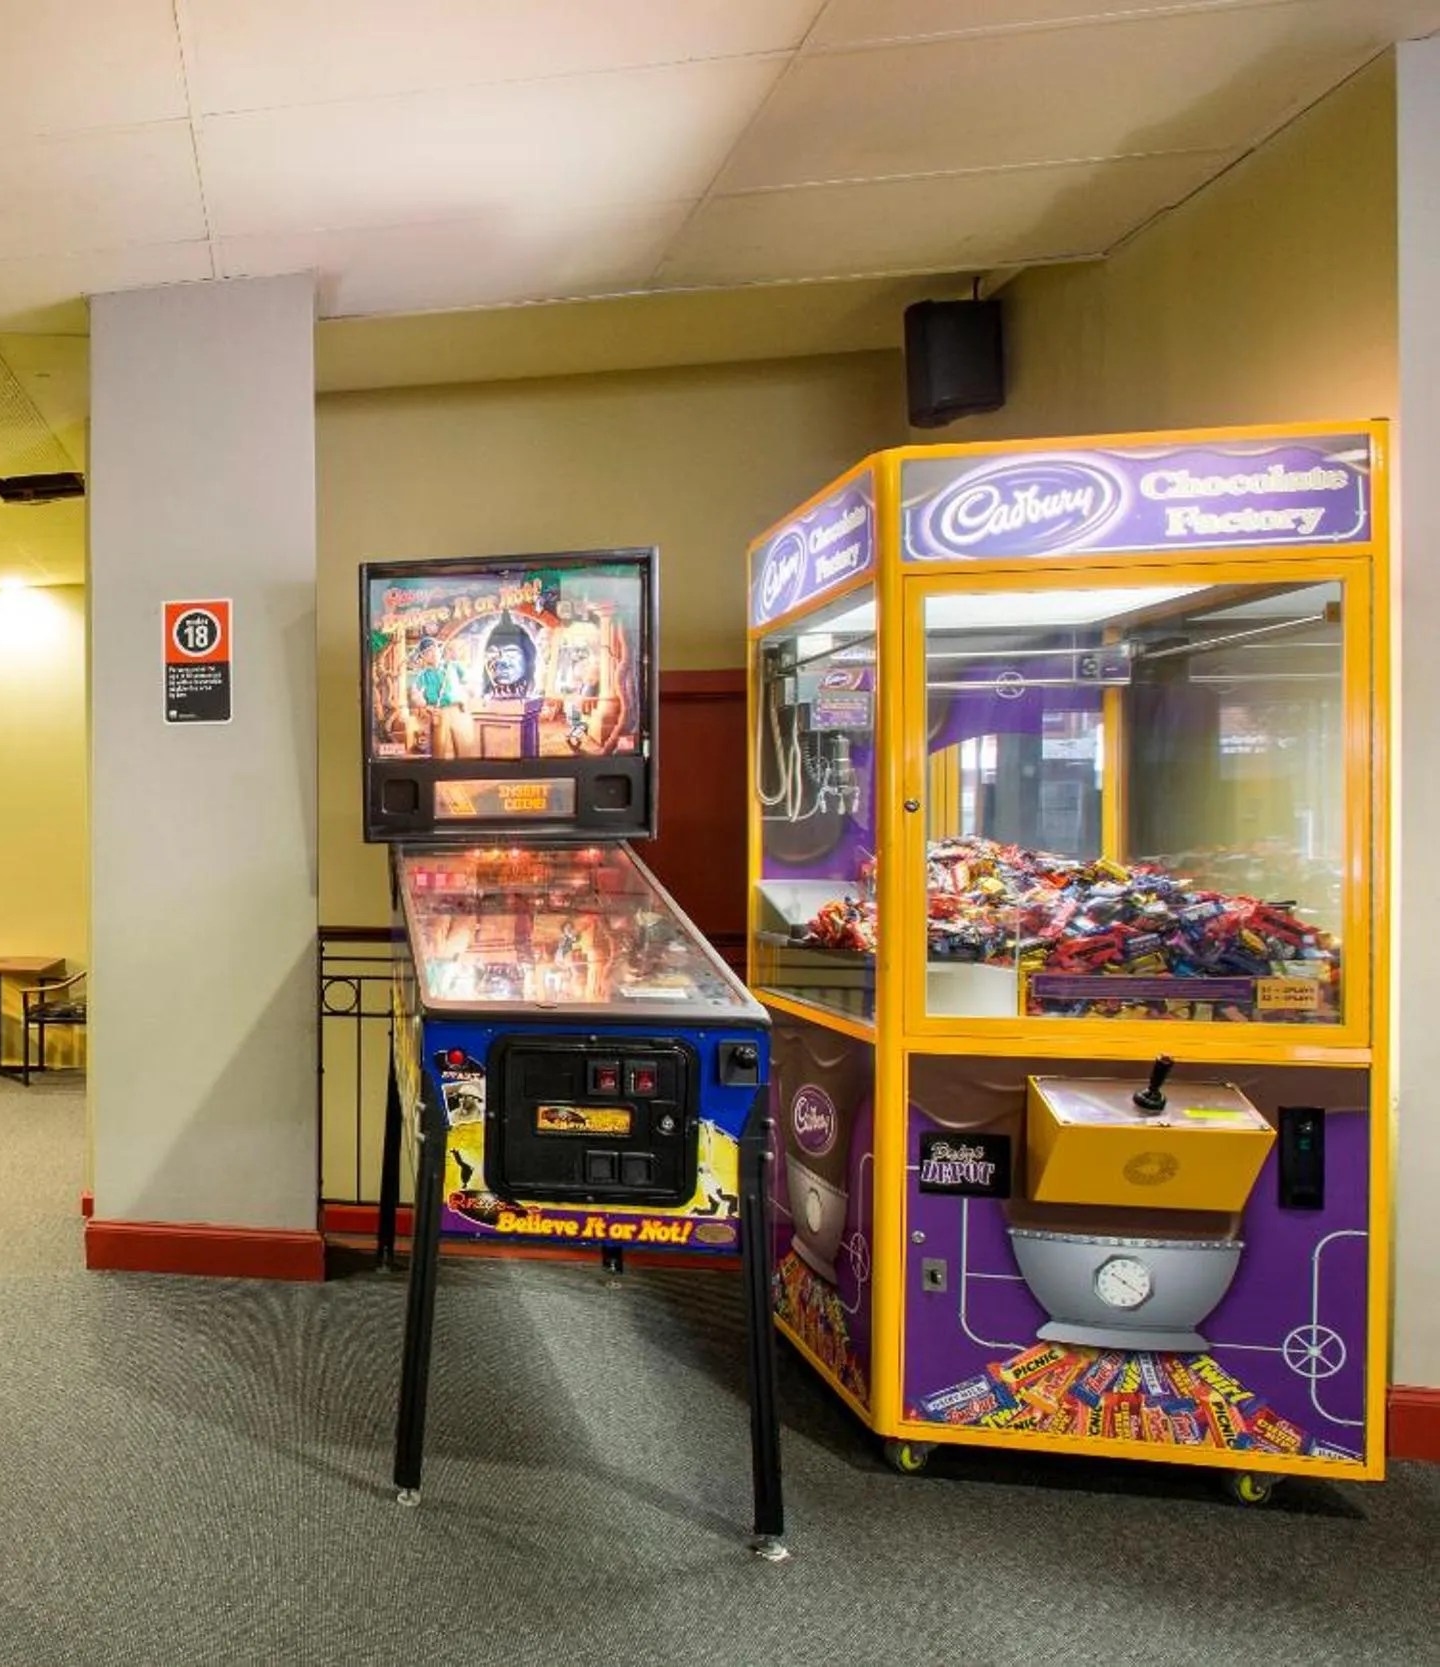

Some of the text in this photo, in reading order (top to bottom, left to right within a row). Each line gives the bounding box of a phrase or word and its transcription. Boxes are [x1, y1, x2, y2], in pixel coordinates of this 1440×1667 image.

[1140, 465, 1349, 500] Chocolate
[940, 485, 1095, 545] Cadbury
[1165, 506, 1326, 537] Factory
[184, 625, 208, 648] 18
[921, 1160, 996, 1185] DEPOT
[496, 1211, 695, 1245] Believe It or Not!
[1013, 1350, 1059, 1378] PICNIC
[1189, 1355, 1256, 1404] Twirl
[1211, 1401, 1237, 1447] PICNIC
